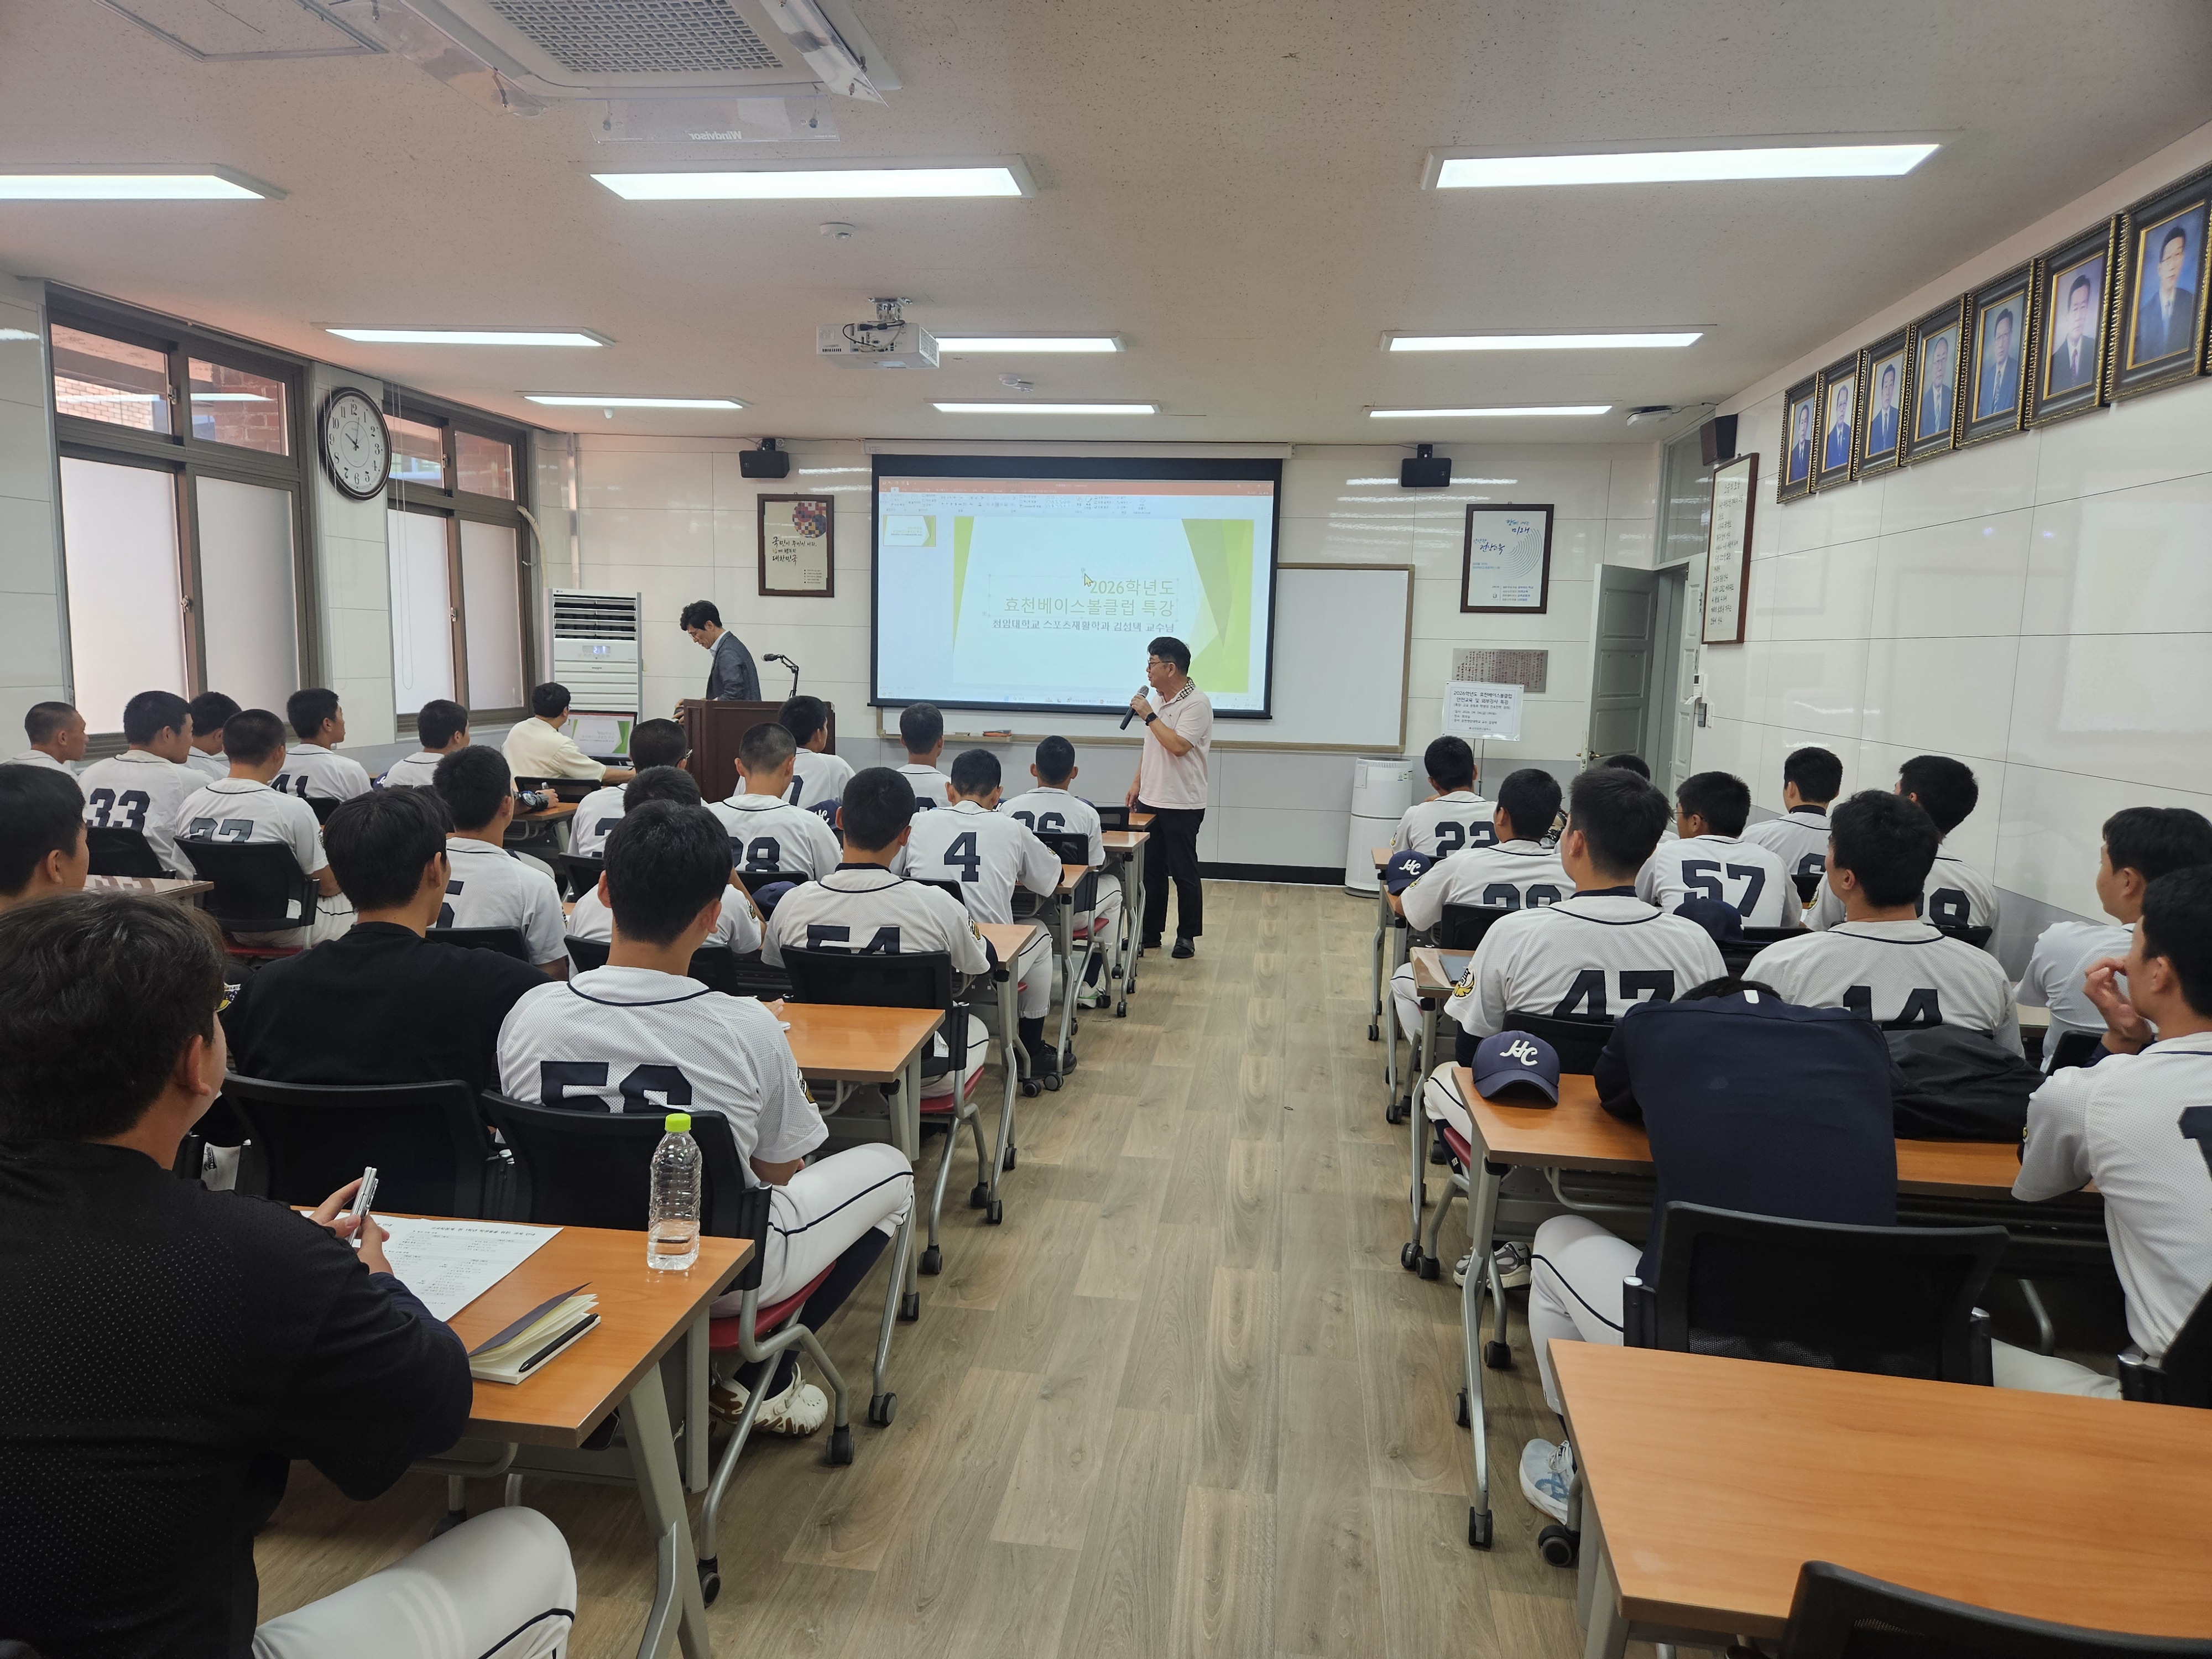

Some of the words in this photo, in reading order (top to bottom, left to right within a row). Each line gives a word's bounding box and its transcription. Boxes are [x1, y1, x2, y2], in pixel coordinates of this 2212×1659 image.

[341, 406, 346, 418] 11
[351, 403, 357, 415] 12
[363, 411, 367, 422] 1
[332, 417, 340, 429] 10
[371, 426, 375, 437] 2
[329, 434, 335, 445] 9
[374, 444, 380, 455] 3
[334, 452, 340, 464] 8
[372, 461, 377, 471] 4
[344, 467, 348, 479] 7
[354, 473, 359, 485] 6
[365, 471, 370, 482] 5
[1512, 526, 1530, 535] 미래
[772, 536, 790, 548] 국민이
[772, 554, 797, 566] 대한민국
[1089, 578, 1175, 596] 2026학년도
[1004, 597, 1134, 616] 효천베이스볼클럽
[1141, 599, 1175, 617] 특강
[1043, 620, 1109, 632] 스포츠재활학과
[1113, 622, 1142, 632] 김성택
[1145, 623, 1175, 633] 교수님
[86, 788, 150, 830] 33
[1435, 821, 1500, 857] 22
[943, 832, 981, 882] 4
[1681, 859, 1766, 918] 57
[806, 925, 900, 954] 54
[1552, 969, 1676, 1022] 47
[1843, 985, 1943, 1024] 14
[1499, 1040, 1538, 1067] HC
